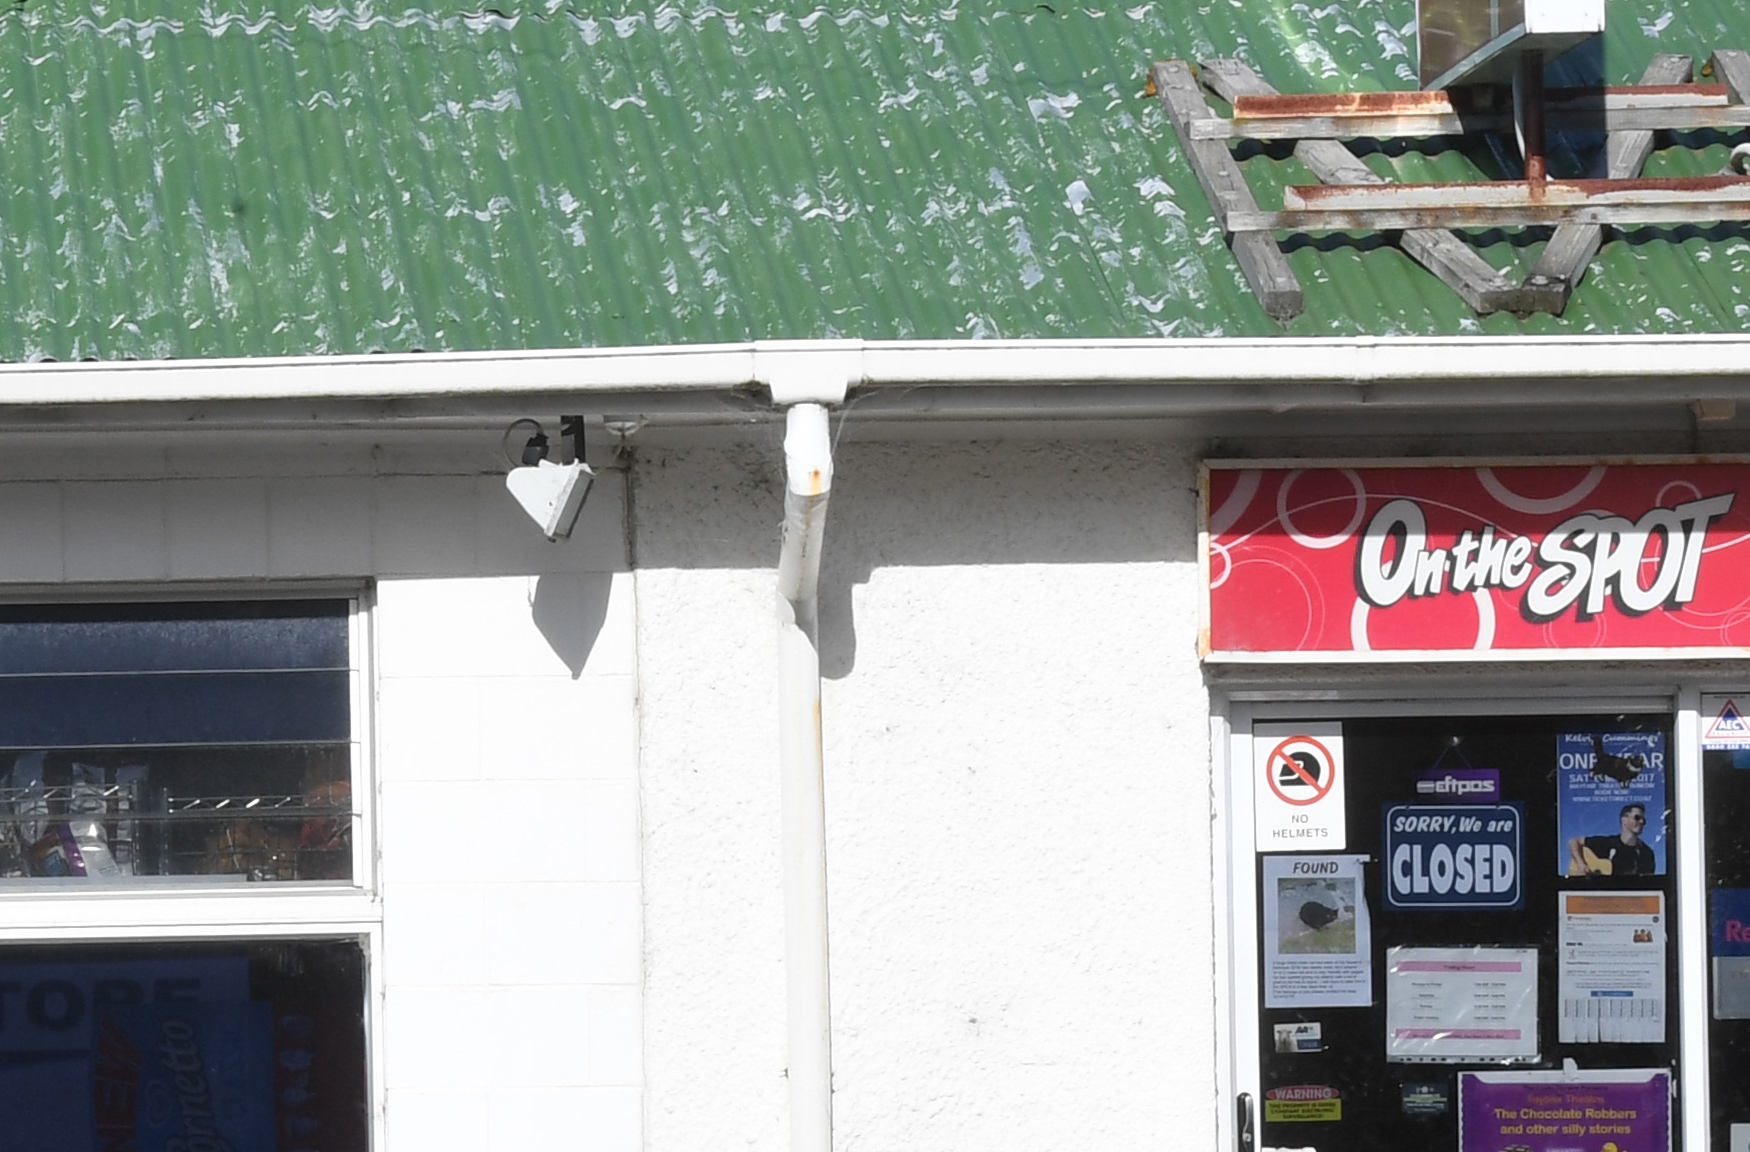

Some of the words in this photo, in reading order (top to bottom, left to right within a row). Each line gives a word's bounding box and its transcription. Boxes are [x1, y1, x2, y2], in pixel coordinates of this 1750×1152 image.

[1357, 497, 1447, 607] On
[1451, 523, 1533, 594] the
[1521, 492, 1737, 622] SPOT
[1718, 720, 1741, 730] AEC
[1435, 775, 1495, 796] eftpos
[1291, 814, 1309, 824] NO
[1392, 814, 1457, 834] SORRY,
[1458, 815, 1483, 832] We
[1486, 819, 1513, 832] are
[1273, 828, 1329, 838] HELMETS
[1292, 861, 1339, 874] FOUND
[1391, 842, 1515, 895] CLOSED
[1275, 1087, 1332, 1100] WARNING
[1494, 1108, 1517, 1119] The
[1520, 1108, 1582, 1119] Chocolate
[1585, 1108, 1637, 1119] Robbers
[1500, 1124, 1523, 1134] and
[1526, 1124, 1558, 1134] other
[1561, 1123, 1586, 1136] silly
[1589, 1124, 1631, 1134] stories
